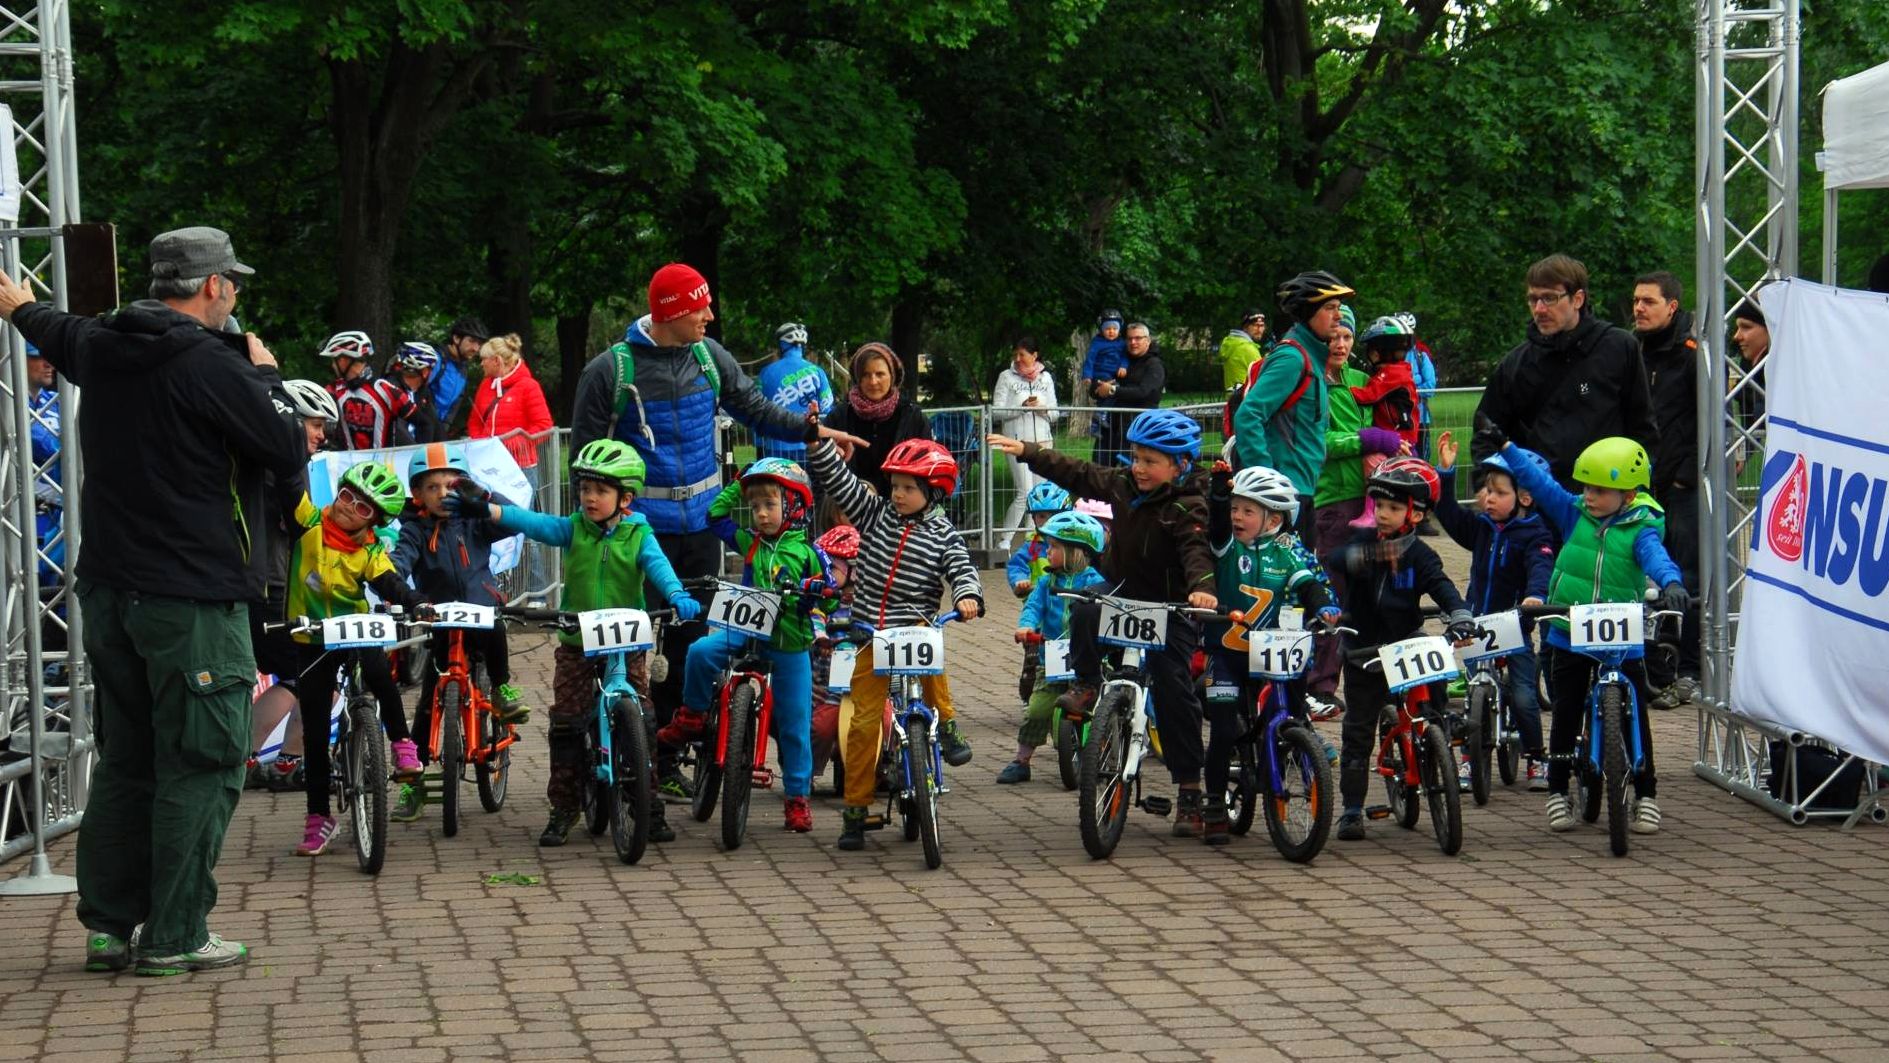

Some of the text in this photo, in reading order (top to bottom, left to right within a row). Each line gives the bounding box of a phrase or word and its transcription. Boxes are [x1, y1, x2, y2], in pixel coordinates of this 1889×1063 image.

[441, 610, 481, 624] 121
[722, 599, 768, 630] 104
[1109, 612, 1157, 642] 108
[335, 620, 386, 640] 118
[592, 619, 640, 646] 117
[1582, 617, 1630, 643] 101
[884, 642, 934, 667] 119
[1260, 647, 1305, 673] 113
[1394, 650, 1445, 680] 110
